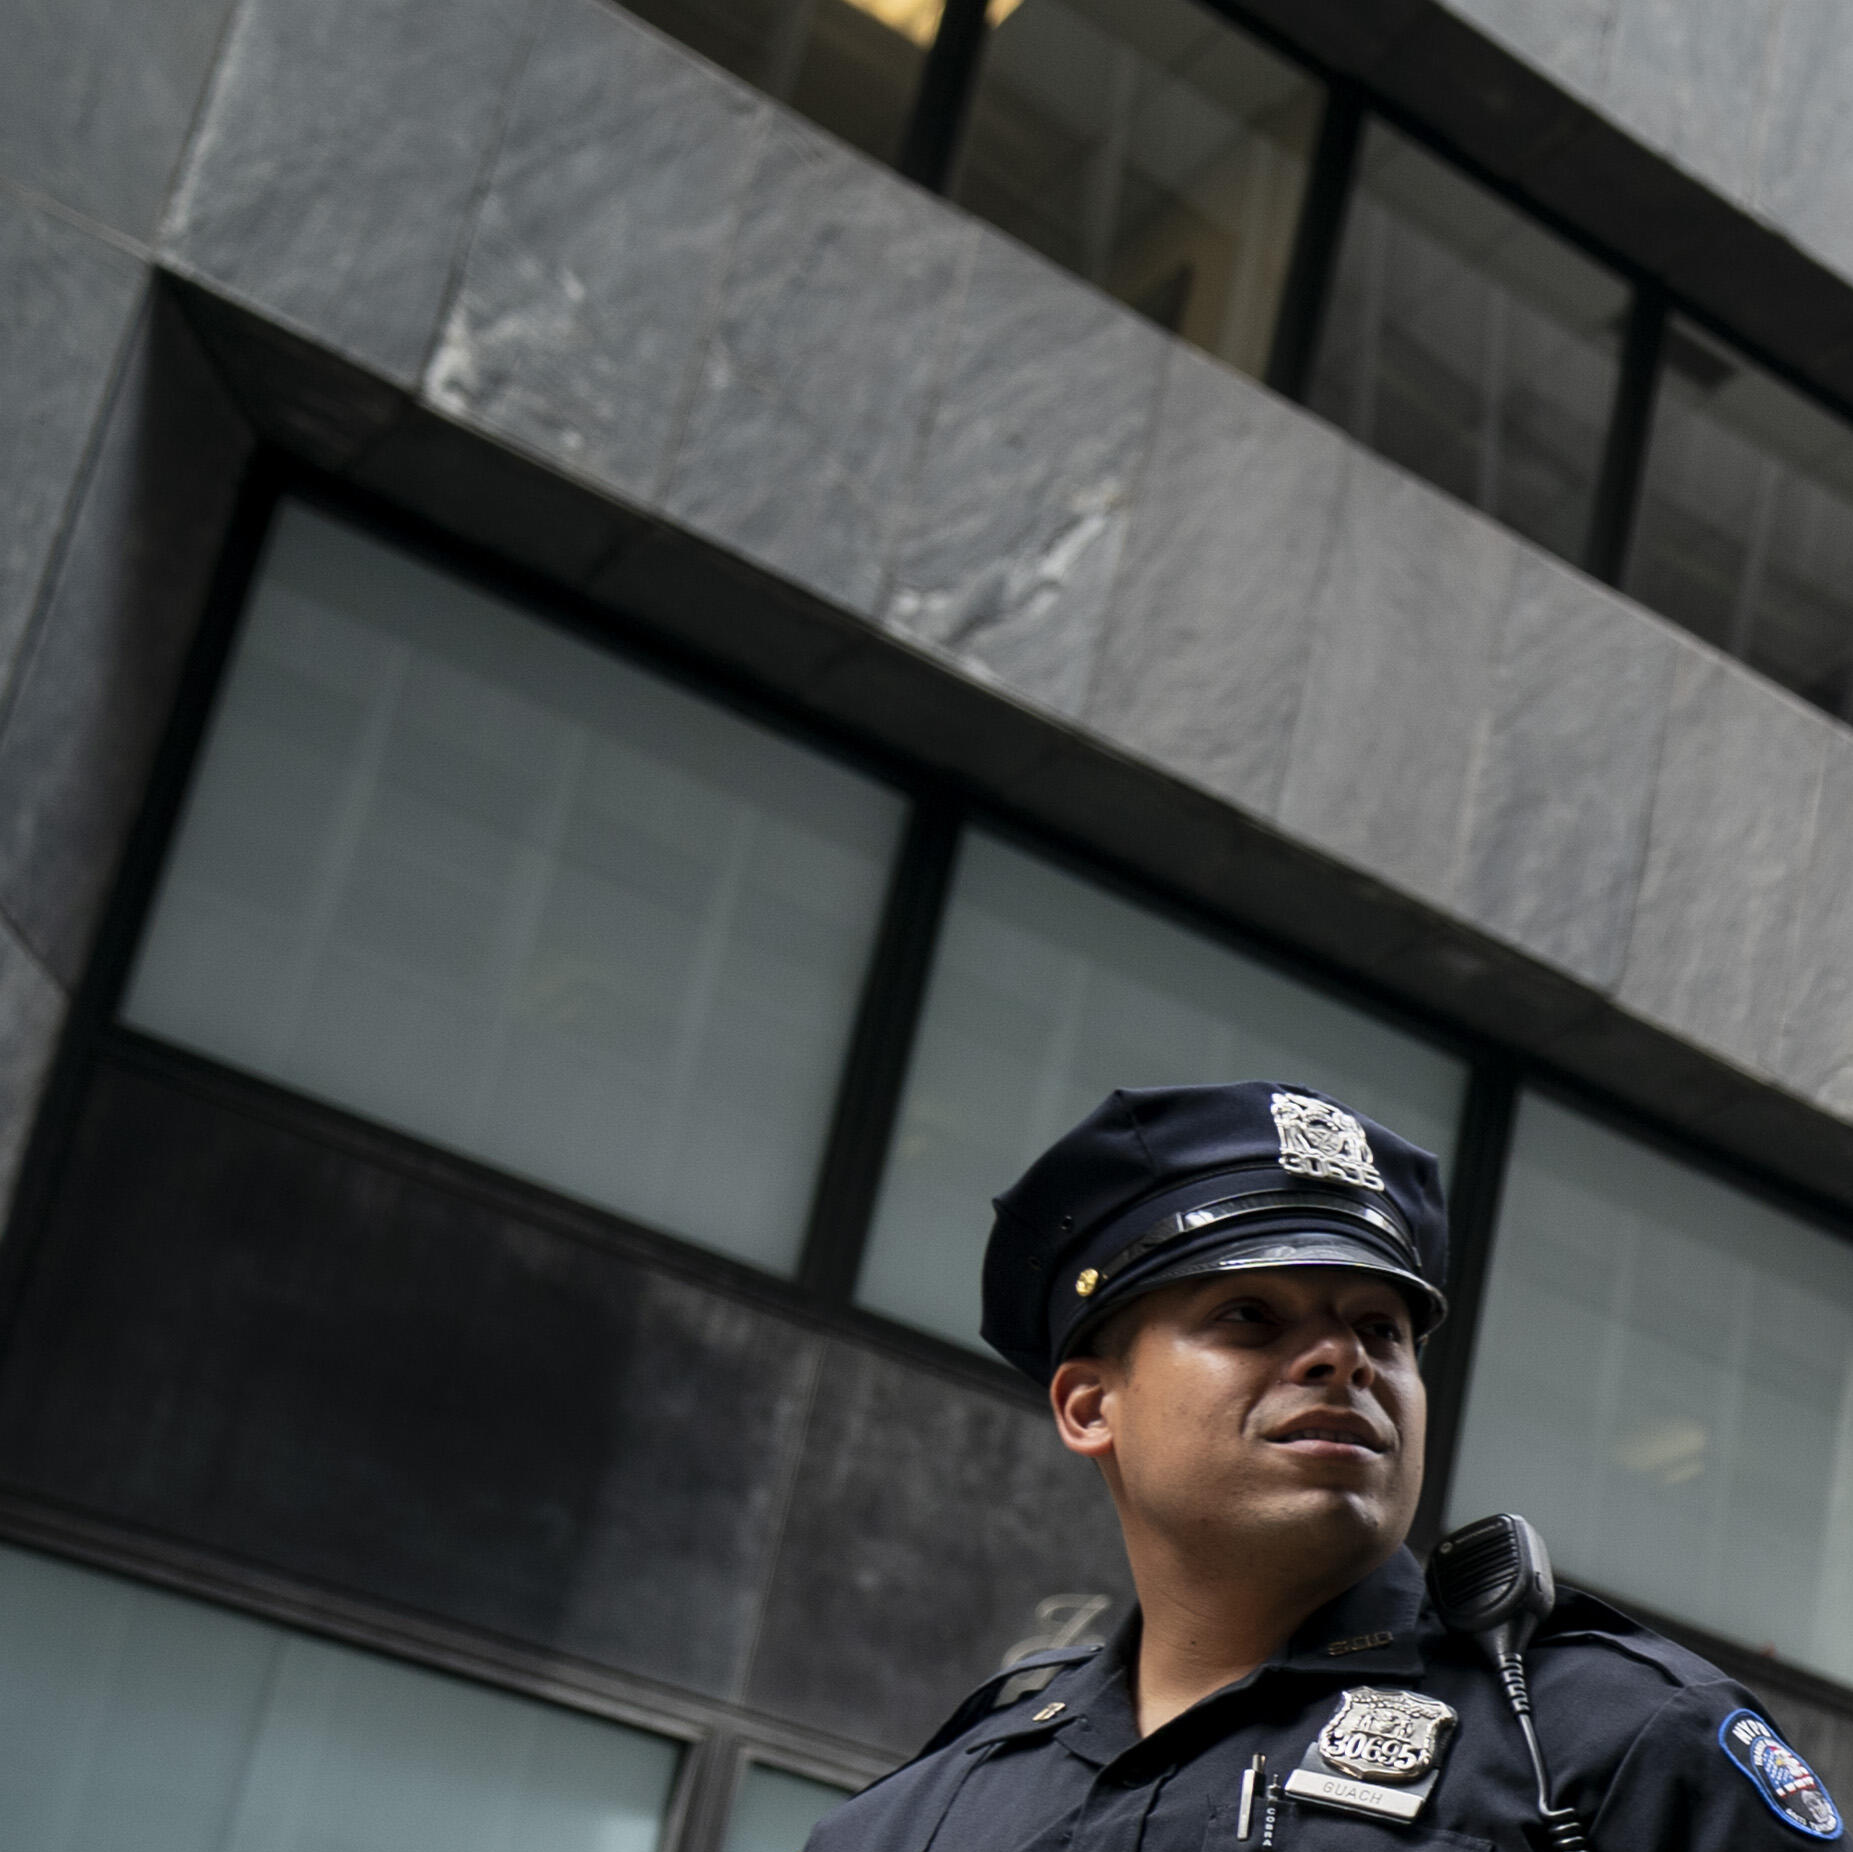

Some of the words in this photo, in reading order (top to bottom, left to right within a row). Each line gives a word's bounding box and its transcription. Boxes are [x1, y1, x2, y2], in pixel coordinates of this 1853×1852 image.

[1732, 1719, 1771, 1745] NYPD
[1326, 1732, 1418, 1770] 30695
[1322, 1781, 1384, 1805] GUACH
[1262, 1808, 1276, 1846] COBRA
